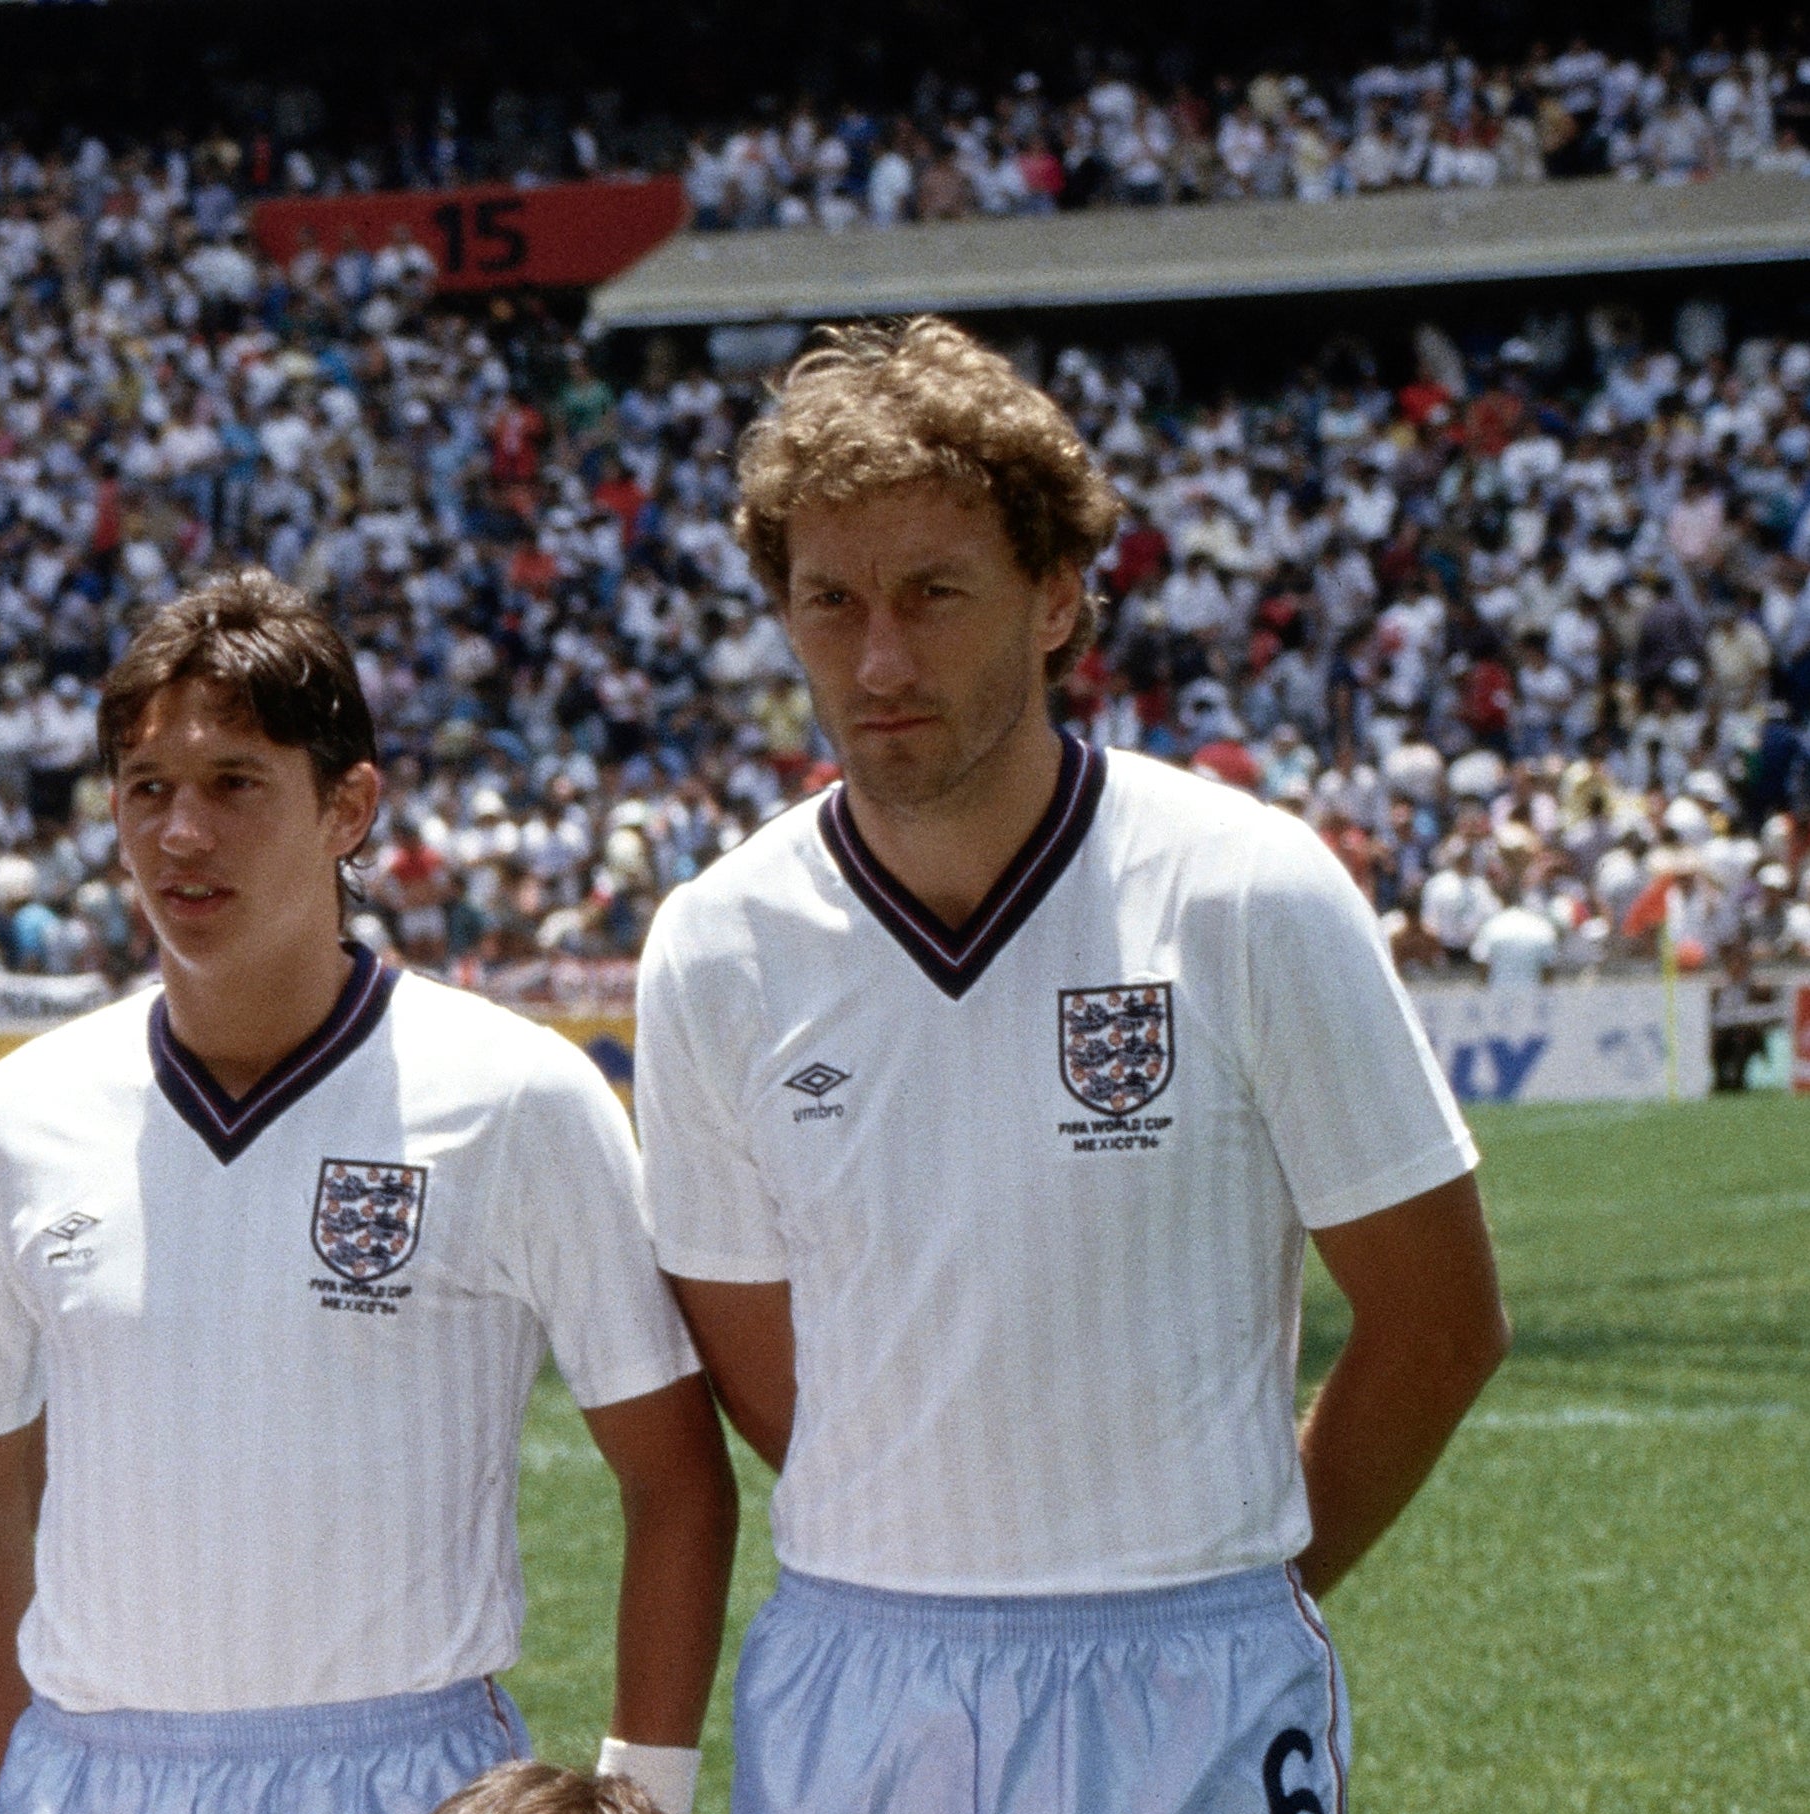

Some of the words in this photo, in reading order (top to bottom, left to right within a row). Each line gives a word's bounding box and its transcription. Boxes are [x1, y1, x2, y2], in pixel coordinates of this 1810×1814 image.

[434, 199, 529, 273] 15
[792, 1102, 844, 1123] umbro
[1059, 1120, 1089, 1136] FIFA
[1091, 1117, 1141, 1133] WORLD
[1144, 1116, 1173, 1131] CUP
[308, 1278, 337, 1293] FIFA
[340, 1281, 385, 1298] WORLD
[387, 1284, 413, 1299] CUP
